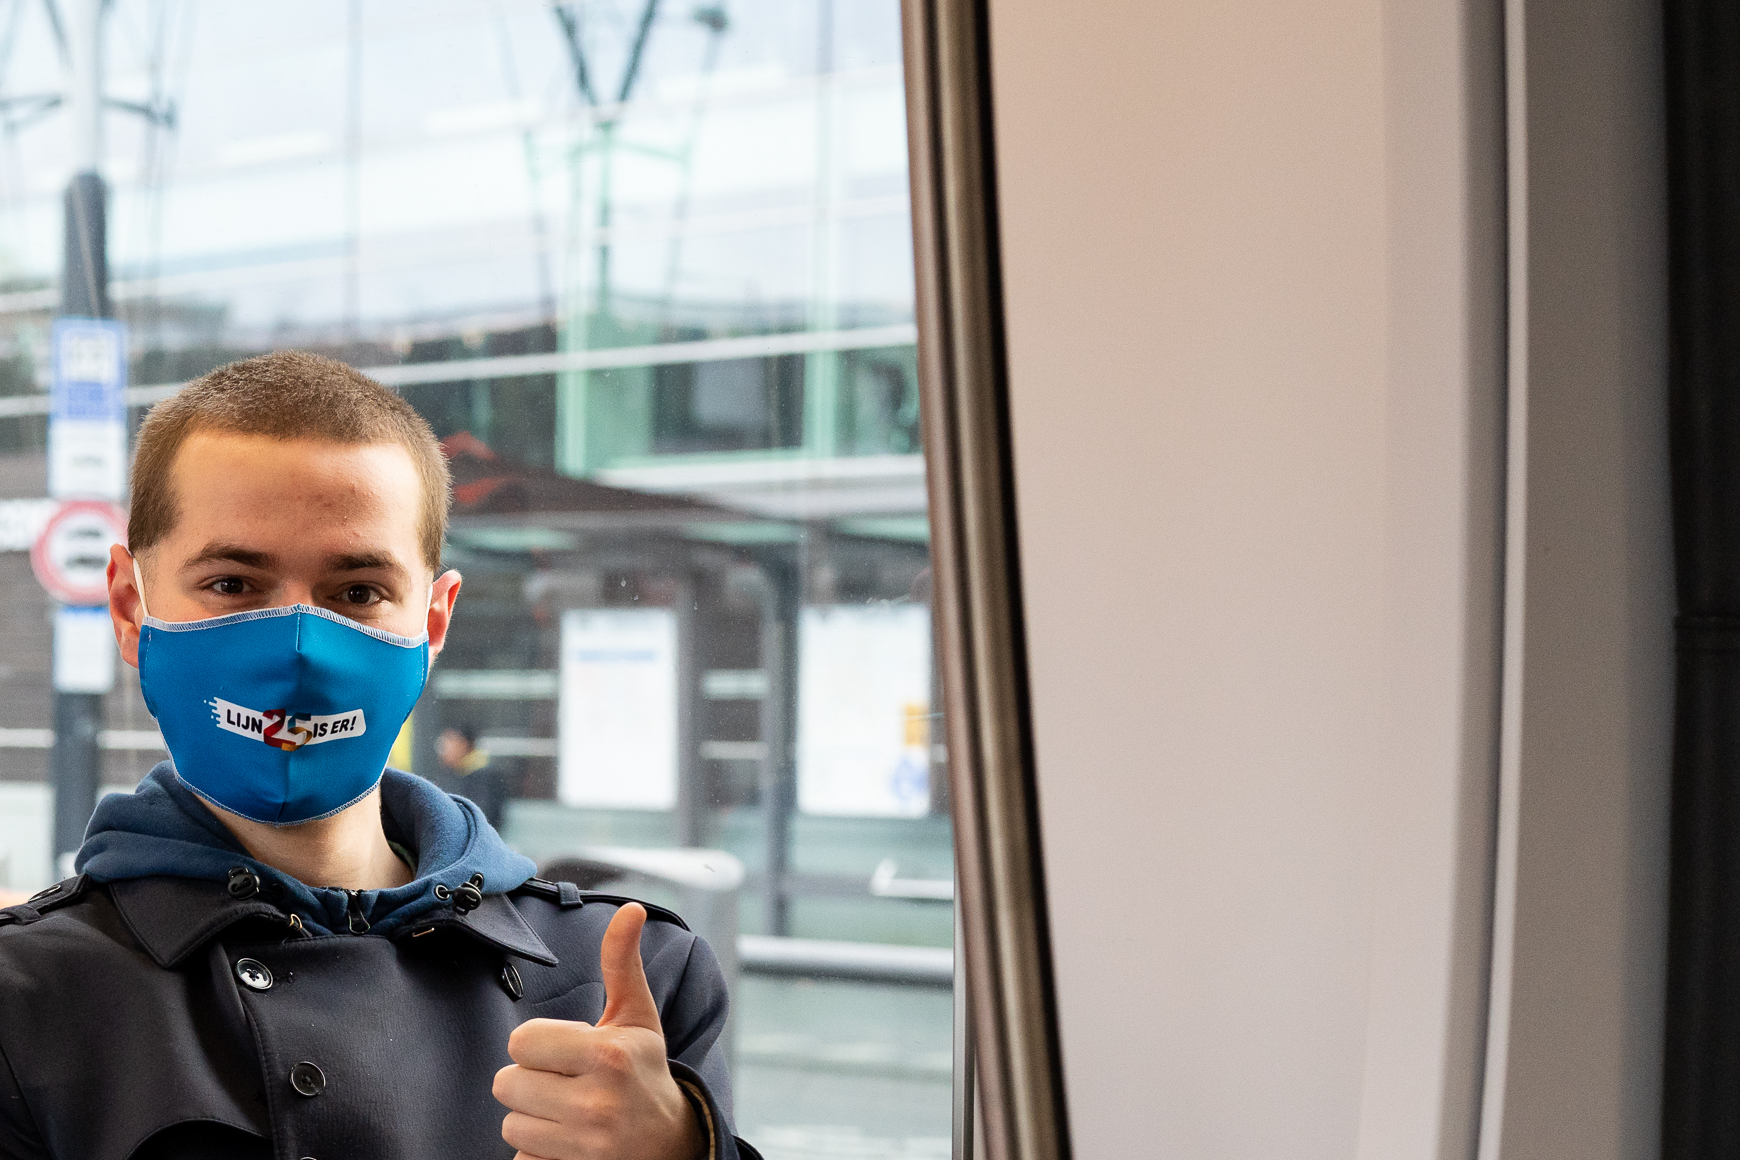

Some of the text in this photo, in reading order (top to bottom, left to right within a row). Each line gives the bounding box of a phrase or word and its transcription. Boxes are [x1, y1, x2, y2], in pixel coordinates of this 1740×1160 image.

[226, 708, 357, 752] LIJN 25 IS ER!
